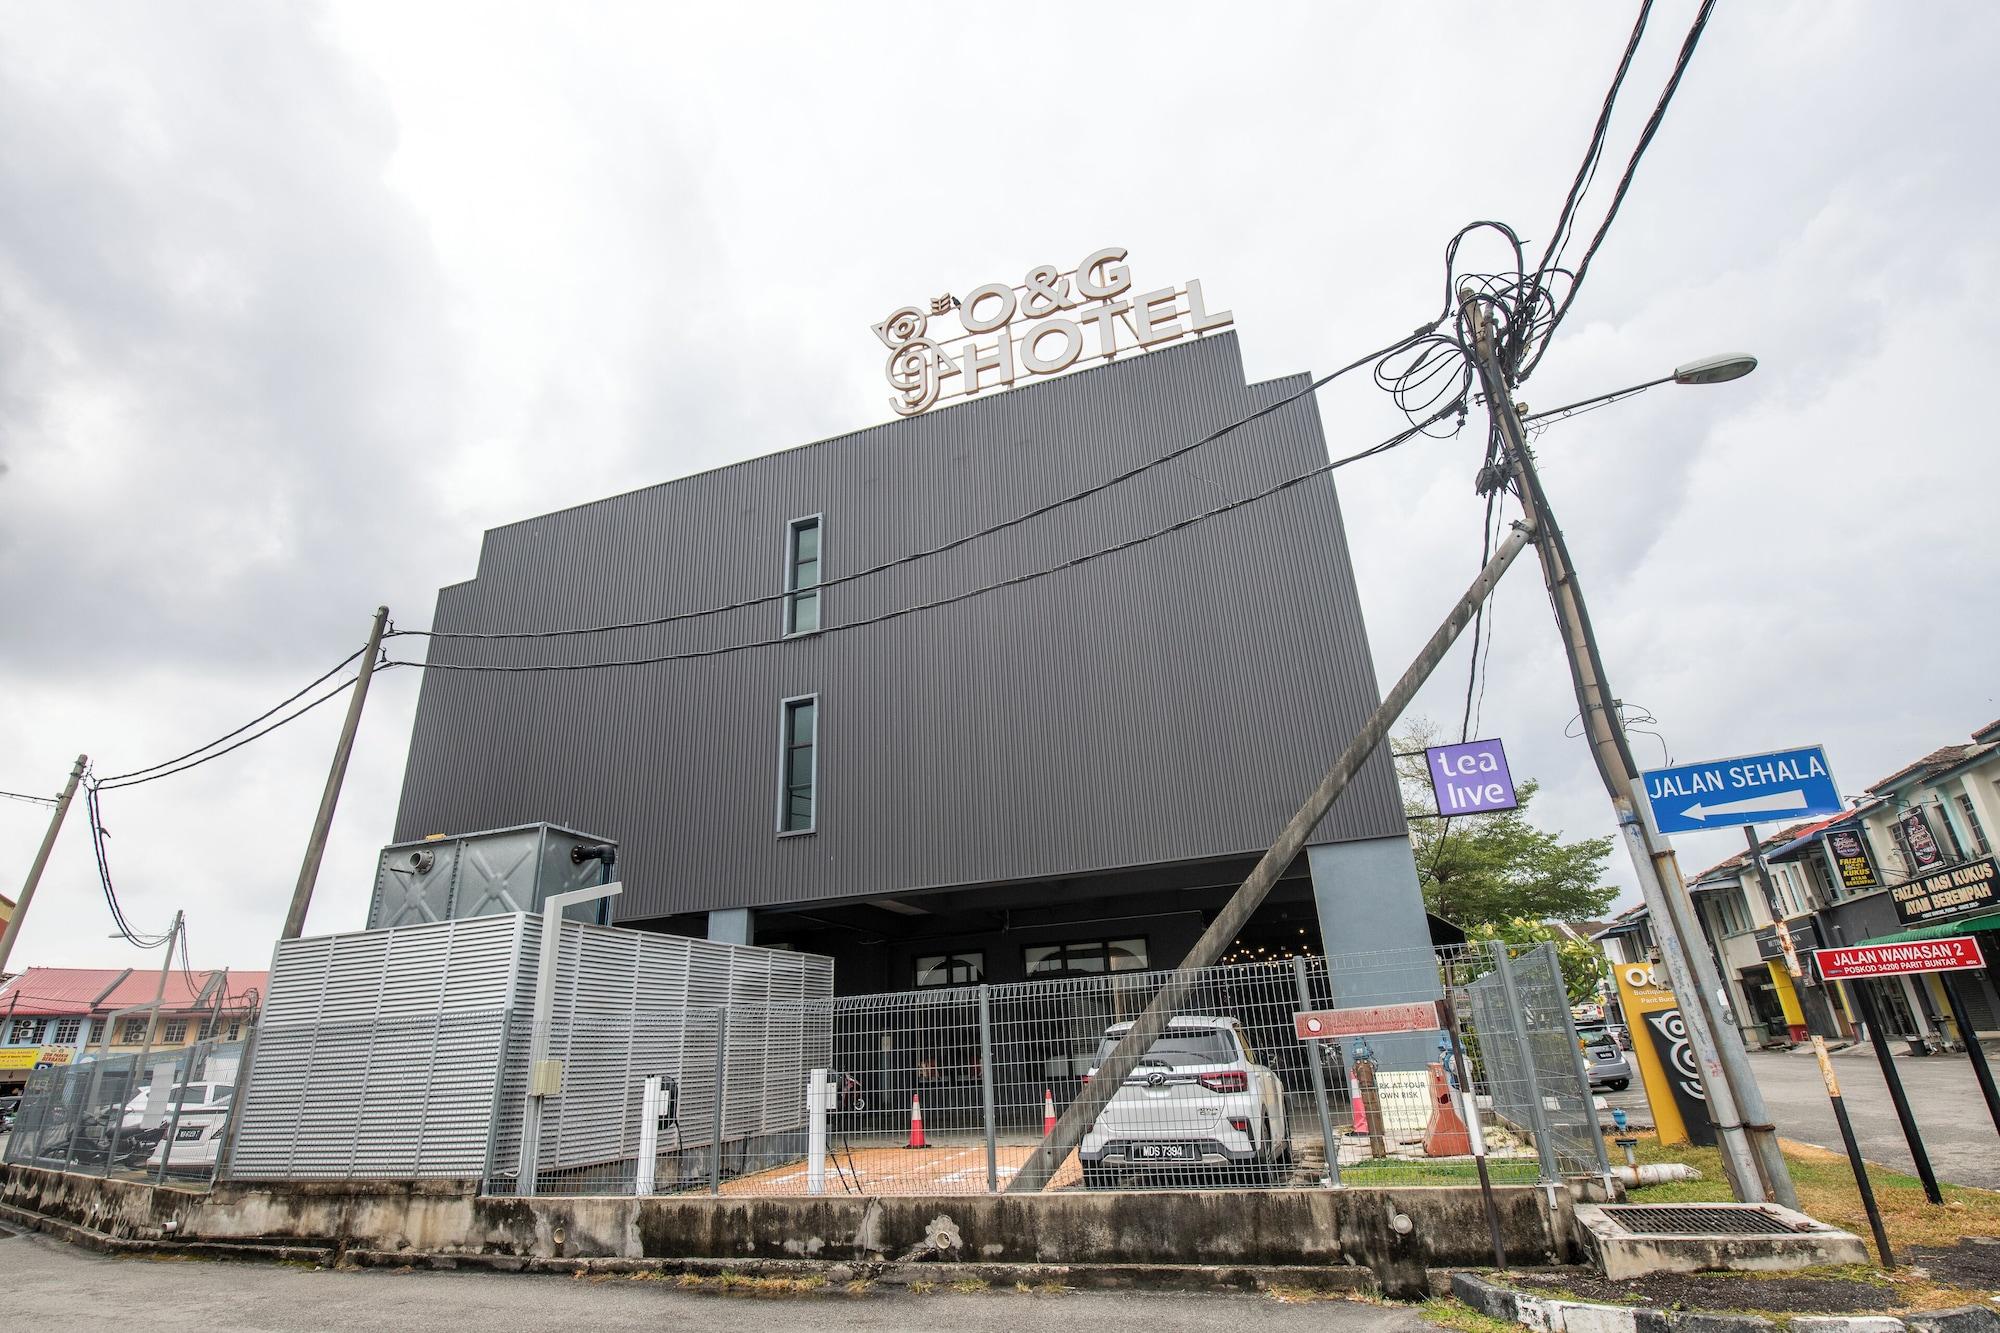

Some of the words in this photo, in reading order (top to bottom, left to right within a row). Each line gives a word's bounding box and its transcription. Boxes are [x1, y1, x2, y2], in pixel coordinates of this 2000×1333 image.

[959, 247, 1131, 334] O&G
[963, 279, 1233, 395] HOTEL
[1437, 748, 1499, 777] tea
[1649, 769, 1725, 799] JALAN
[1729, 756, 1828, 788] SEHALA
[1447, 783, 1505, 809] live
[1840, 857, 1865, 865] FAIZAL
[1843, 868, 1870, 877] KUKUS
[1892, 882, 1926, 902] FAIZAL
[1925, 874, 1953, 893] NASI
[1951, 862, 1994, 886] KUKUS
[1905, 897, 1932, 915] AYAM
[1931, 881, 1992, 909] BEREMPAH
[1833, 951, 1877, 966] JALAN
[1880, 944, 1953, 962] WAWASAN
[1954, 943, 1964, 956] 2
[1844, 964, 1877, 974] POSKOD
[1878, 963, 1900, 972] 34200
[1900, 961, 1922, 970] PARIT
[1925, 958, 1957, 968] BUNTAR
[1401, 1091, 1418, 1099] RISK
[1143, 1146, 1160, 1156] MDS
